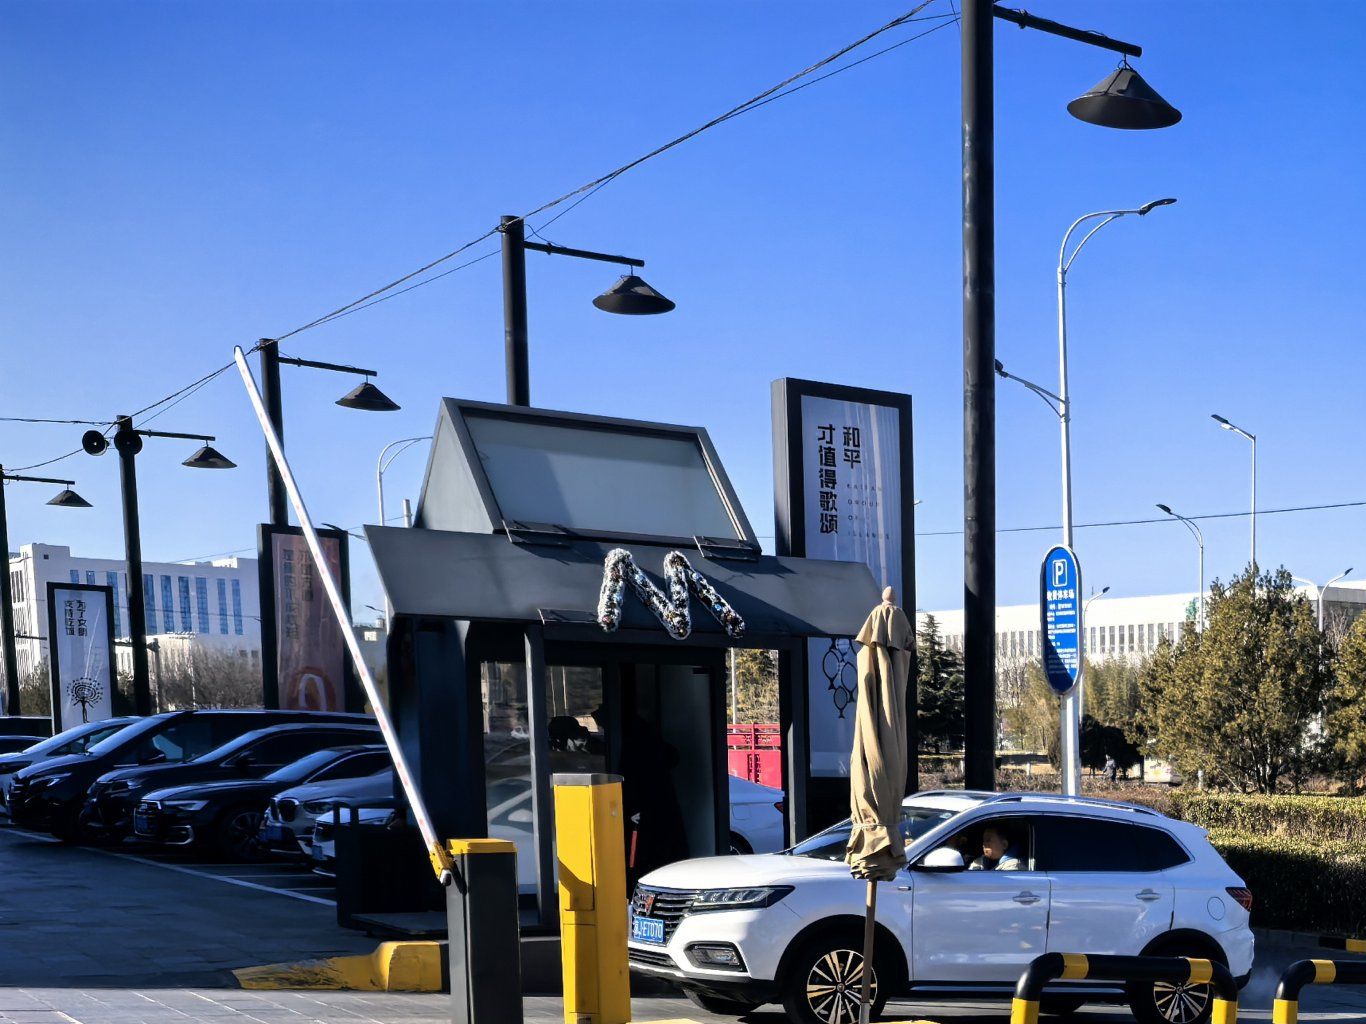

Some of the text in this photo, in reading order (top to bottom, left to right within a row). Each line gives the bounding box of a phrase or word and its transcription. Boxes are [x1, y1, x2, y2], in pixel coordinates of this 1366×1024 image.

[842, 426, 862, 469] 和平
[817, 423, 838, 534] 才值得歌颂
[1055, 562, 1064, 585] P
